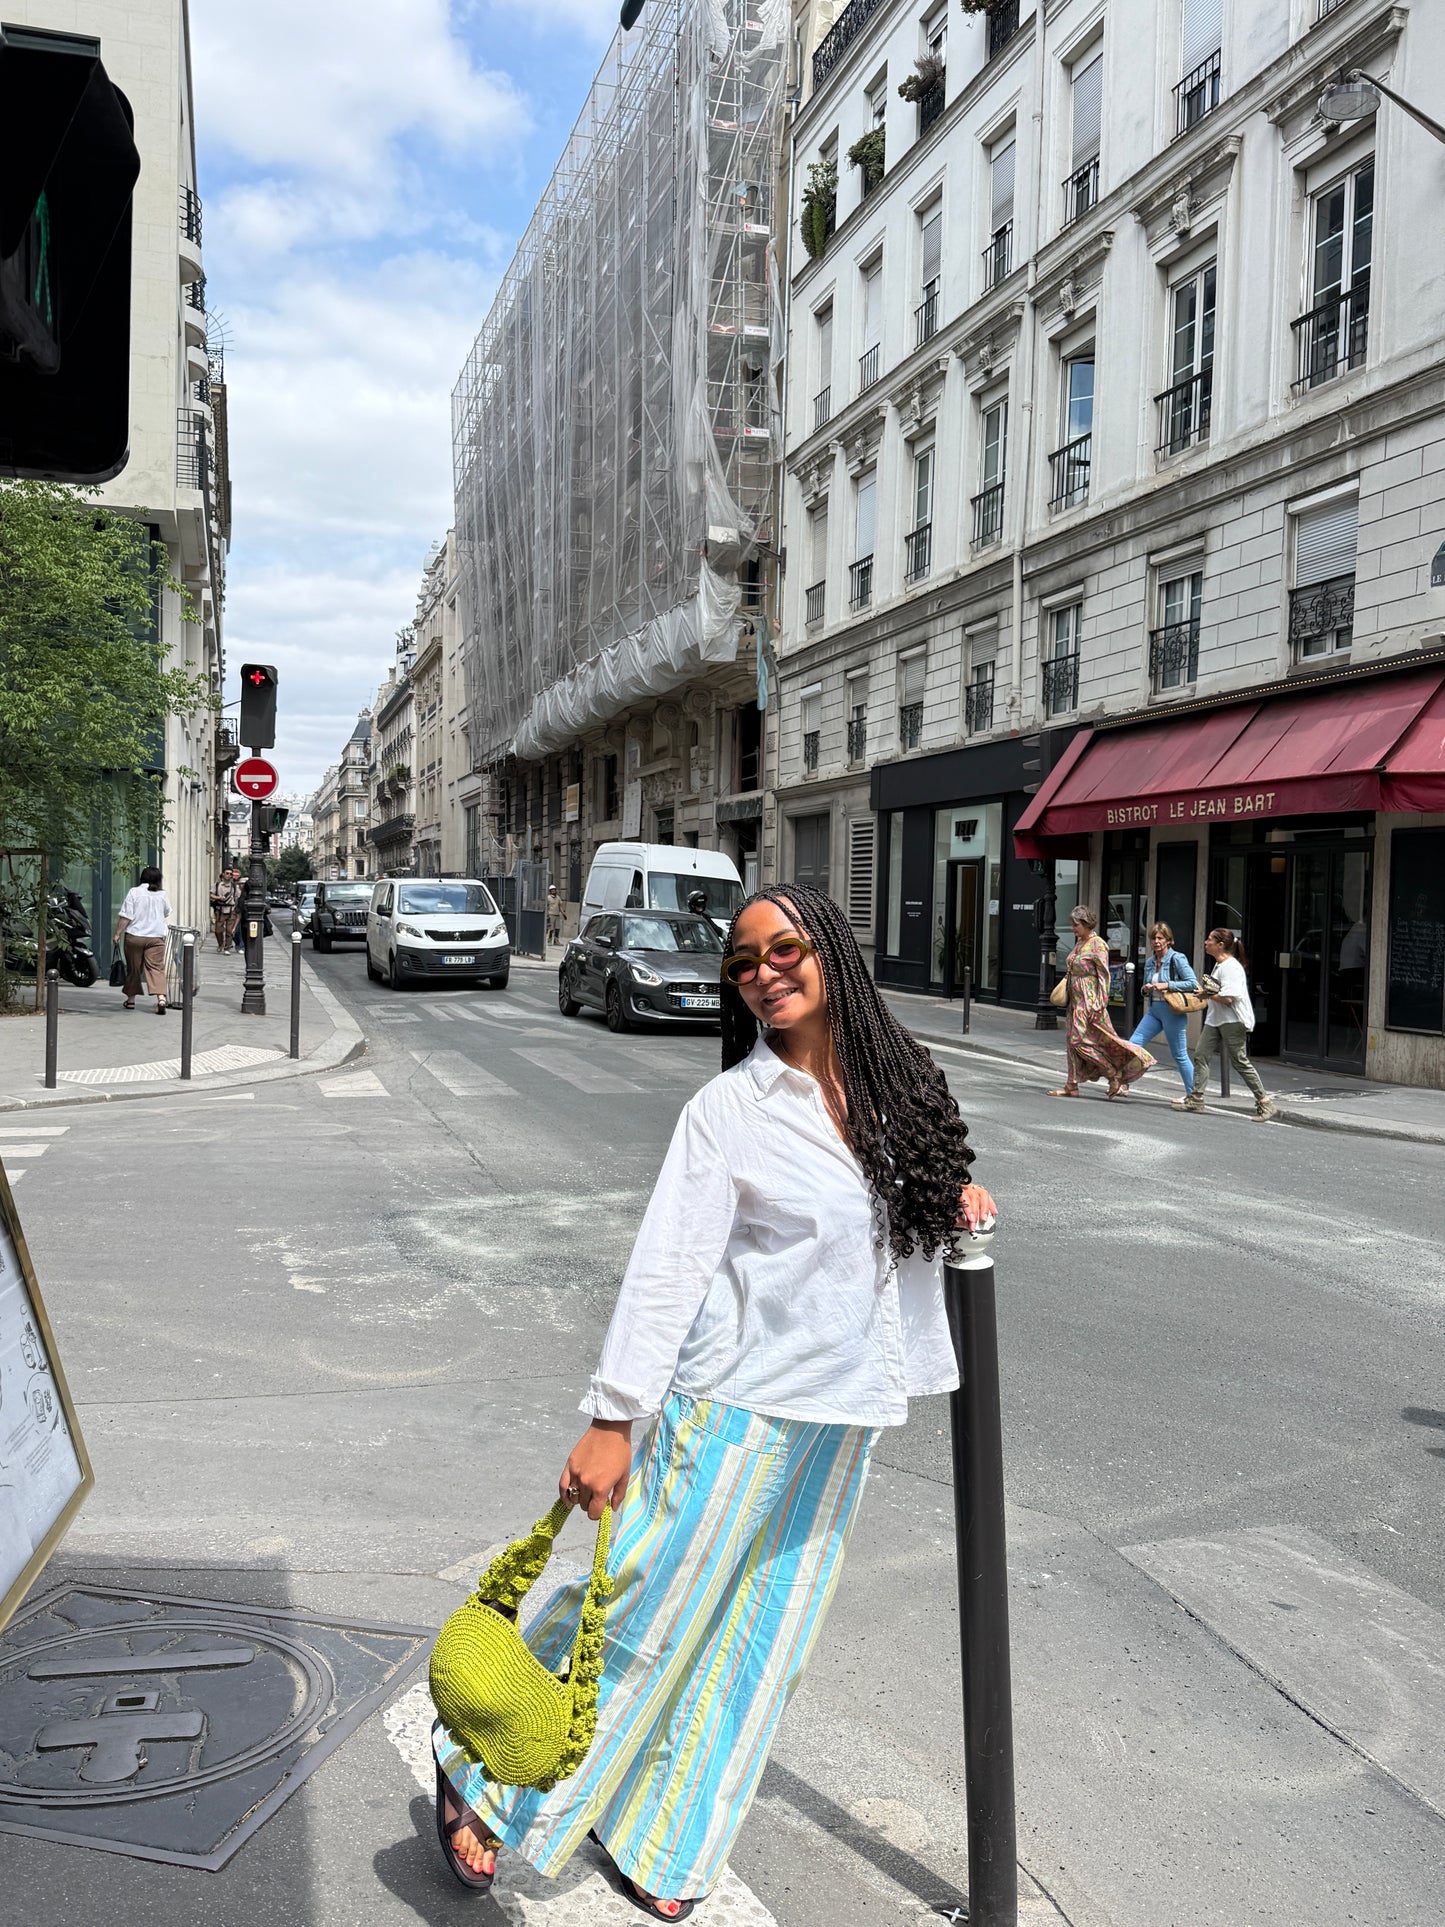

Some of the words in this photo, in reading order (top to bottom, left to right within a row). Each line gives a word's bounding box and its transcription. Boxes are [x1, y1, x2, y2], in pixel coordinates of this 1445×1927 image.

[1432, 574, 1442, 584] LE
[1107, 804, 1158, 824] BISTROT
[1170, 802, 1185, 818] LE
[1190, 799, 1226, 817] JEAN
[1234, 792, 1275, 814] BART
